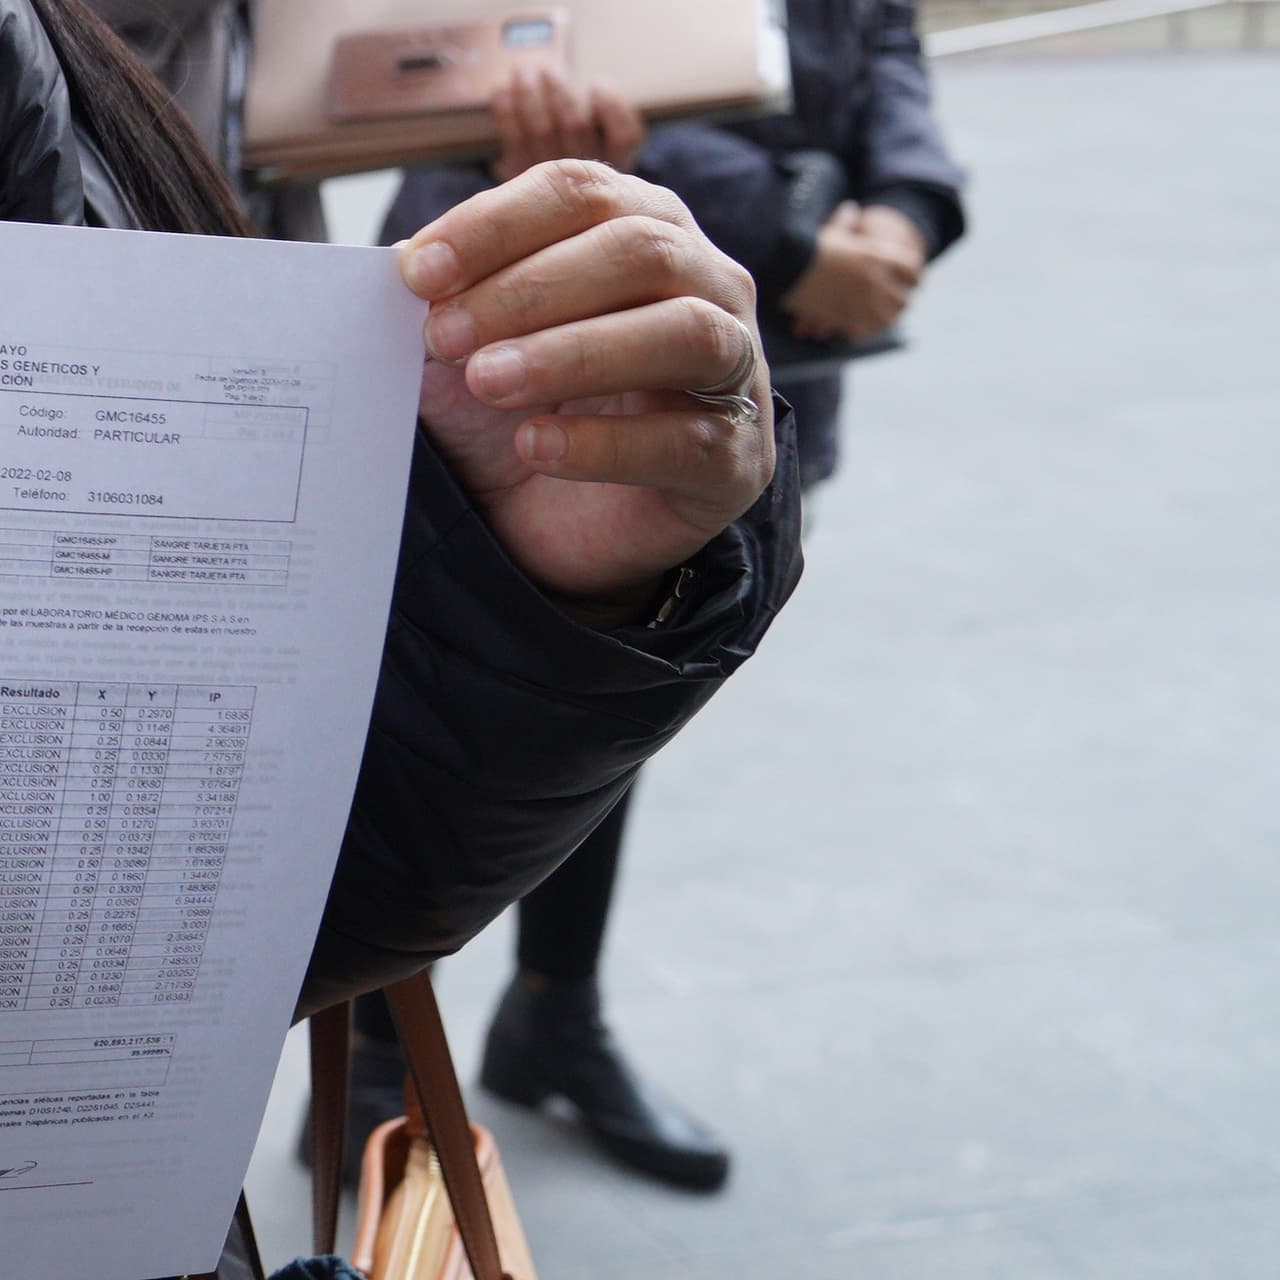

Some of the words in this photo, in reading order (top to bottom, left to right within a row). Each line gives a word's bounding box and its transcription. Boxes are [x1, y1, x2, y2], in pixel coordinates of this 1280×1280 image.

[92, 365, 100, 376] Y
[96, 410, 167, 425] GMC16455
[94, 429, 180, 445] PARTICULAR
[0, 467, 72, 482] 2022-02-08
[88, 492, 163, 505] 3106031084
[3, 609, 19, 618] por
[31, 608, 104, 620] LABORATORIO
[109, 610, 144, 622] MÉDICO
[147, 612, 190, 624] GENOMA
[0, 686, 60, 699] Resultado
[98, 690, 106, 700] X
[148, 691, 156, 701] Y
[210, 693, 221, 703] IP
[3, 705, 66, 717] EXCLUSION
